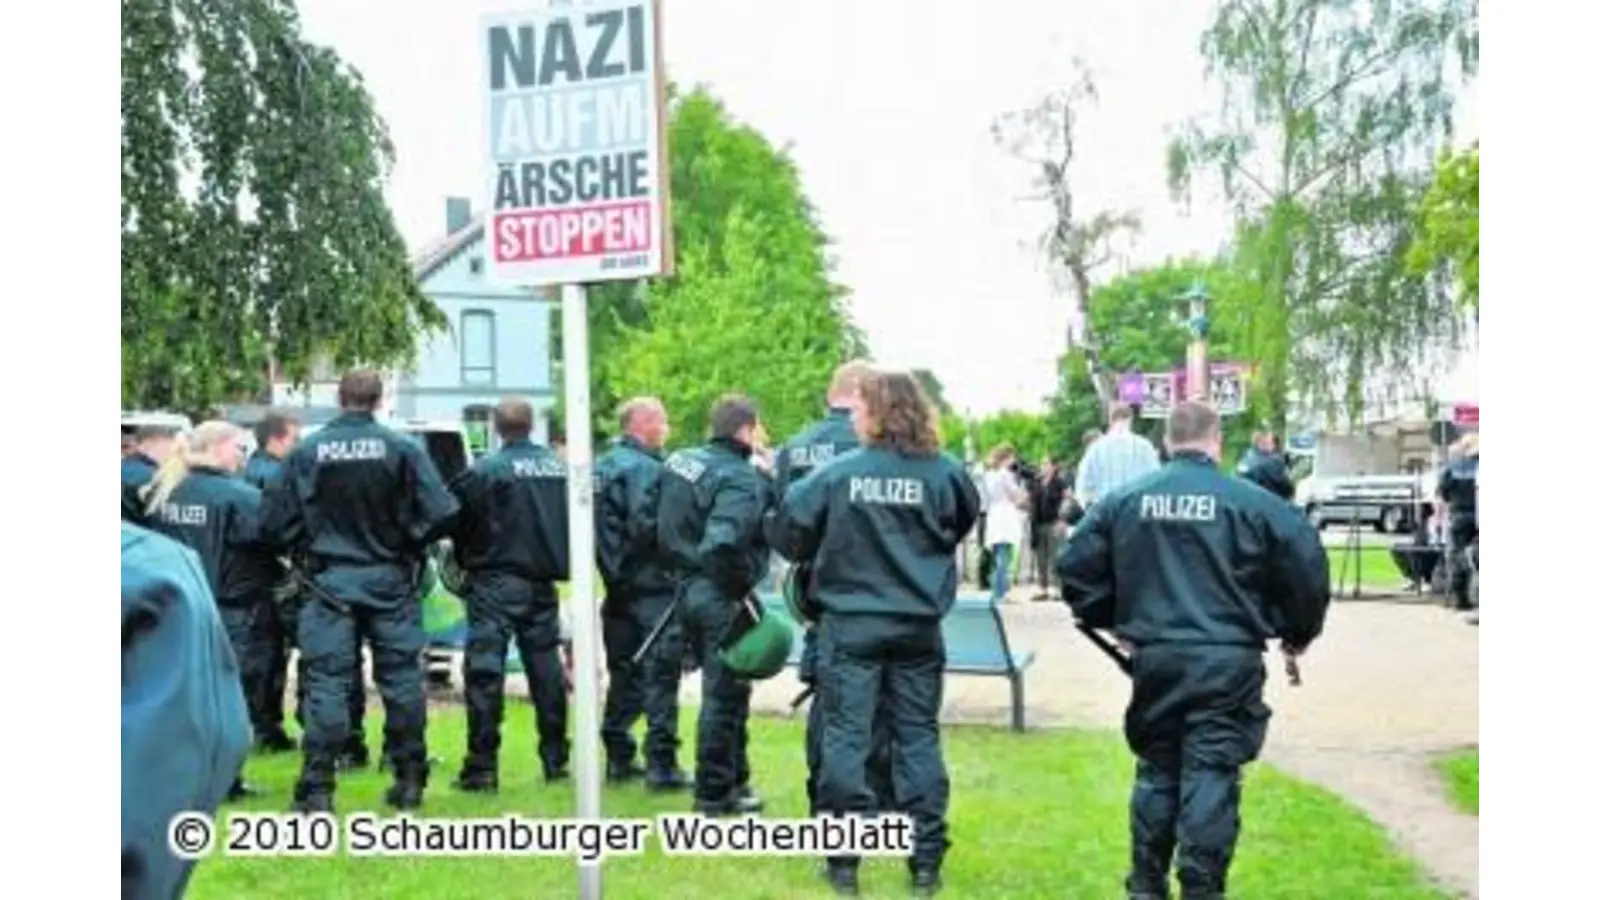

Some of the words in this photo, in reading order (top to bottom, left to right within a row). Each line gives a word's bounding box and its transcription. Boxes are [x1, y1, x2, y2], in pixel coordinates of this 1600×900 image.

[488, 4, 646, 90] NAZI
[496, 81, 647, 157] AUFM
[494, 151, 649, 210] ÄRSCHE
[501, 207, 648, 260] STOPPEN
[316, 438, 387, 462] POLIZEI
[849, 477, 924, 505] POLIZEI
[1141, 494, 1216, 521] POLIZEI
